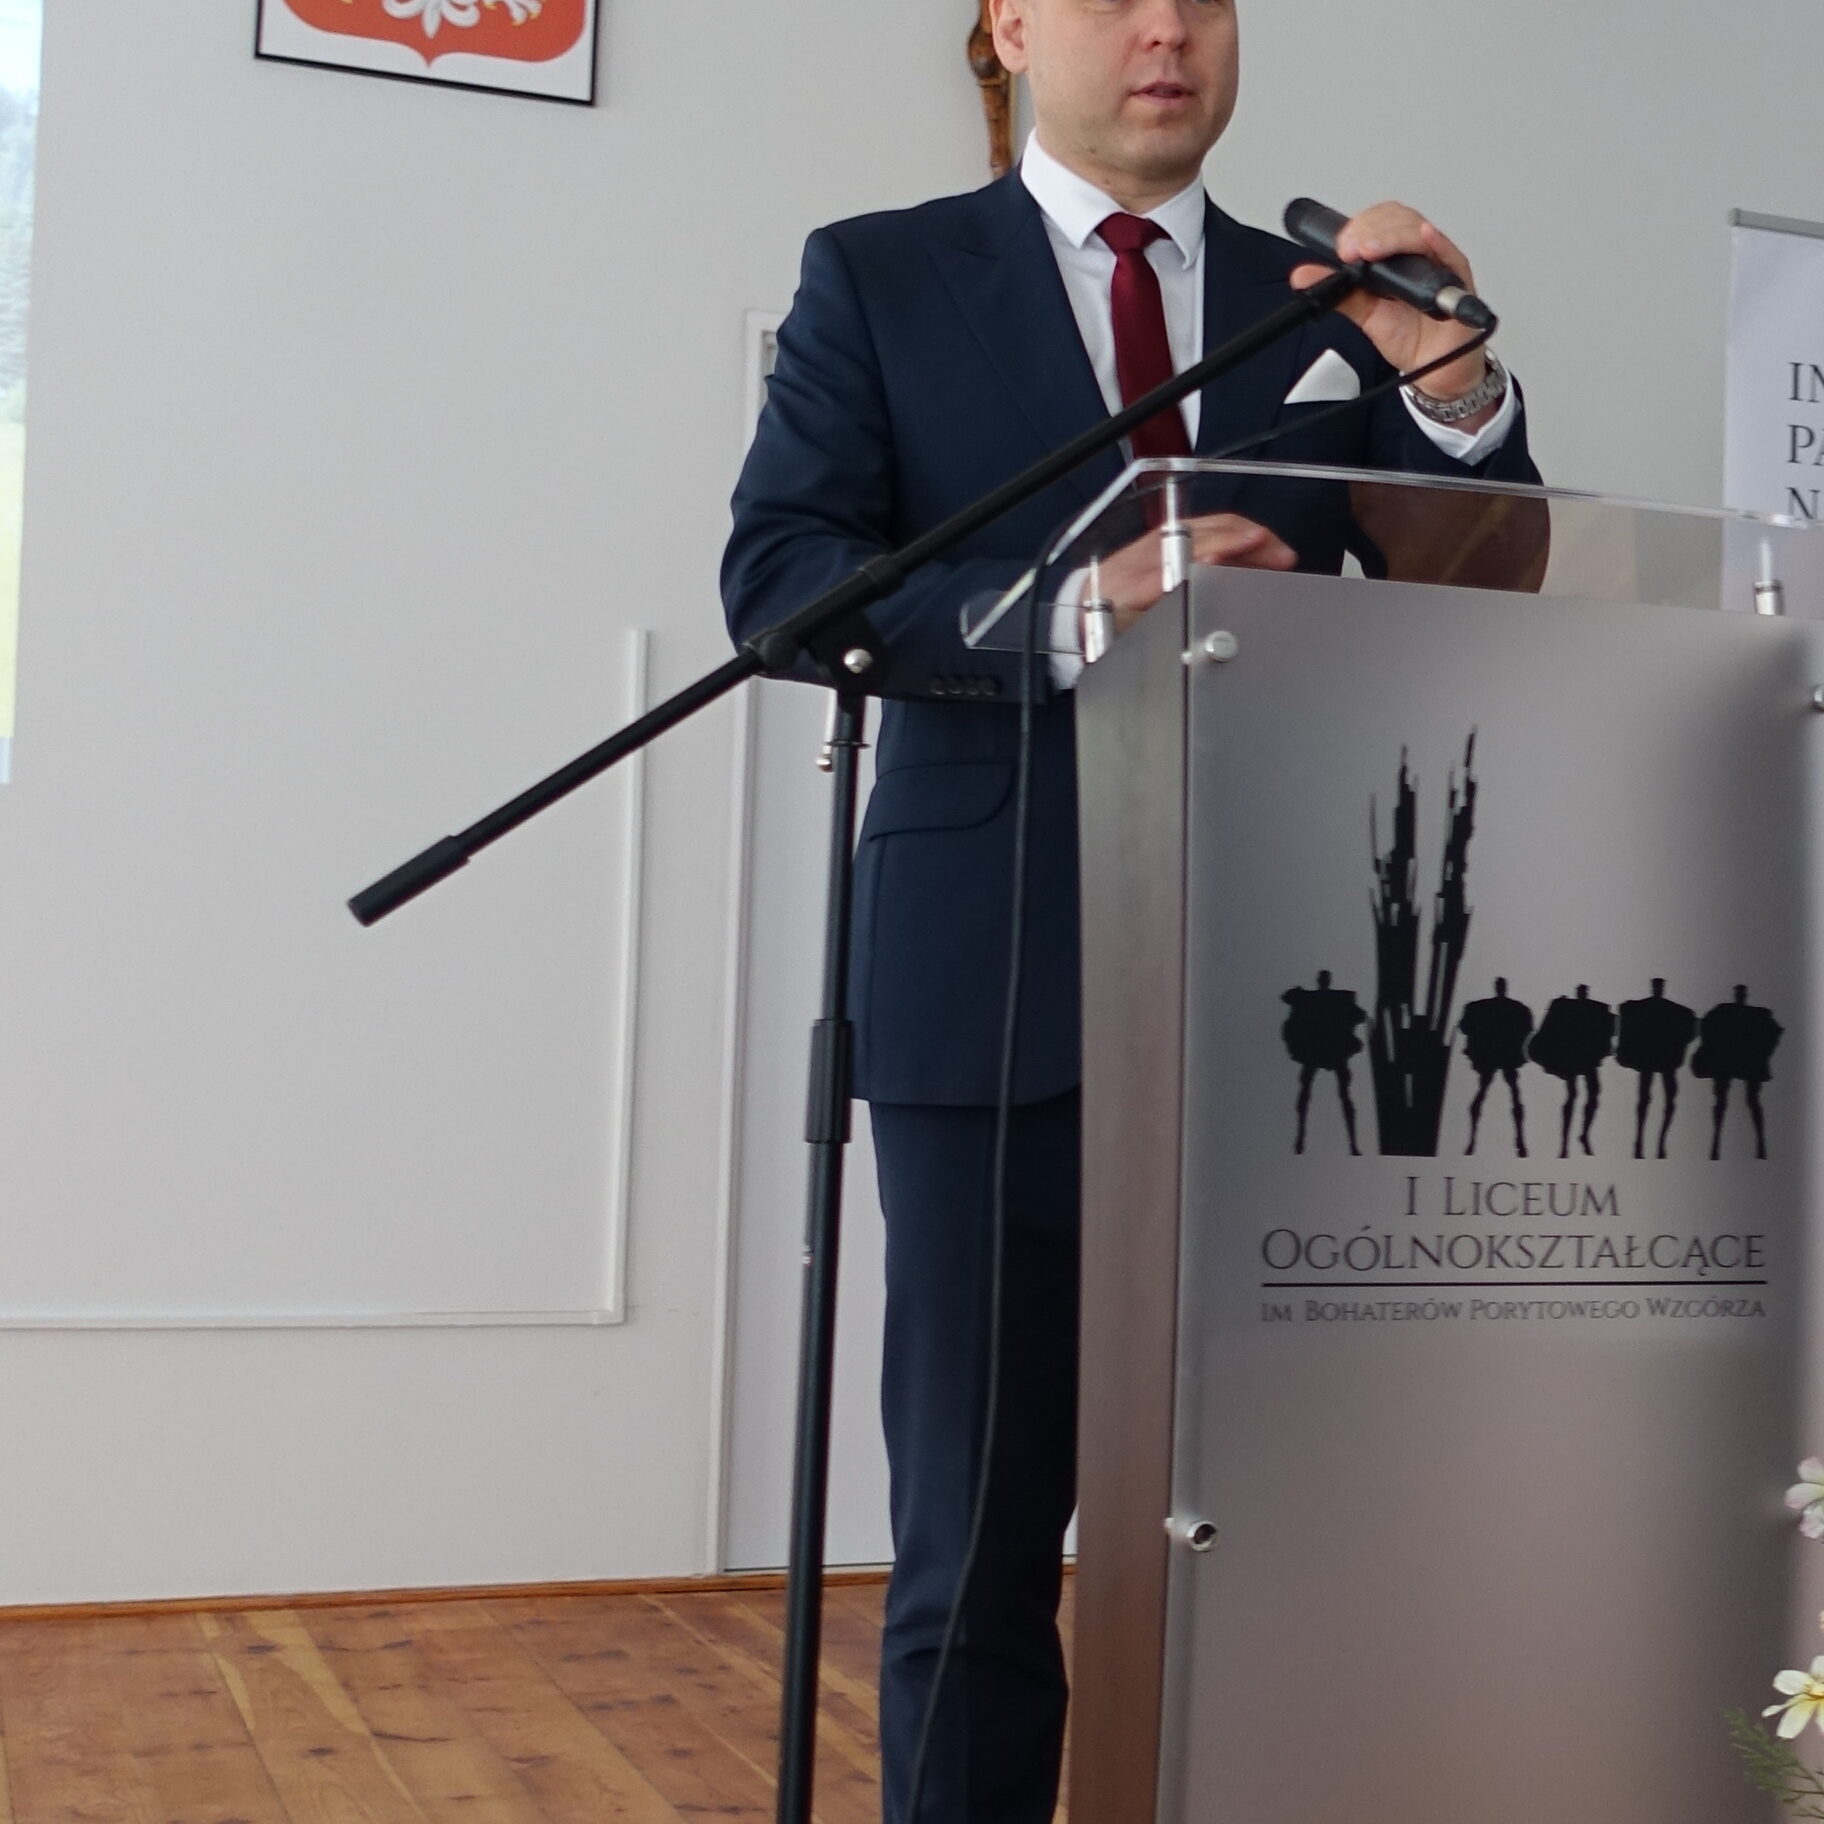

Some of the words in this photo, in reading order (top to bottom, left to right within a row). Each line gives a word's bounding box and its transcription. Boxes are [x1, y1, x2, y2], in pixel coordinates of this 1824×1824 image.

[1405, 1176, 1420, 1215] I
[1443, 1176, 1620, 1217] LICEUM
[1262, 1225, 1767, 1276] OGÓLNOKSZTAŁCĄCE
[1304, 1298, 1464, 1322] BOHATERÓW
[1469, 1299, 1641, 1321] PORYTOWEGO
[1645, 1295, 1767, 1319] WZGÓRZA
